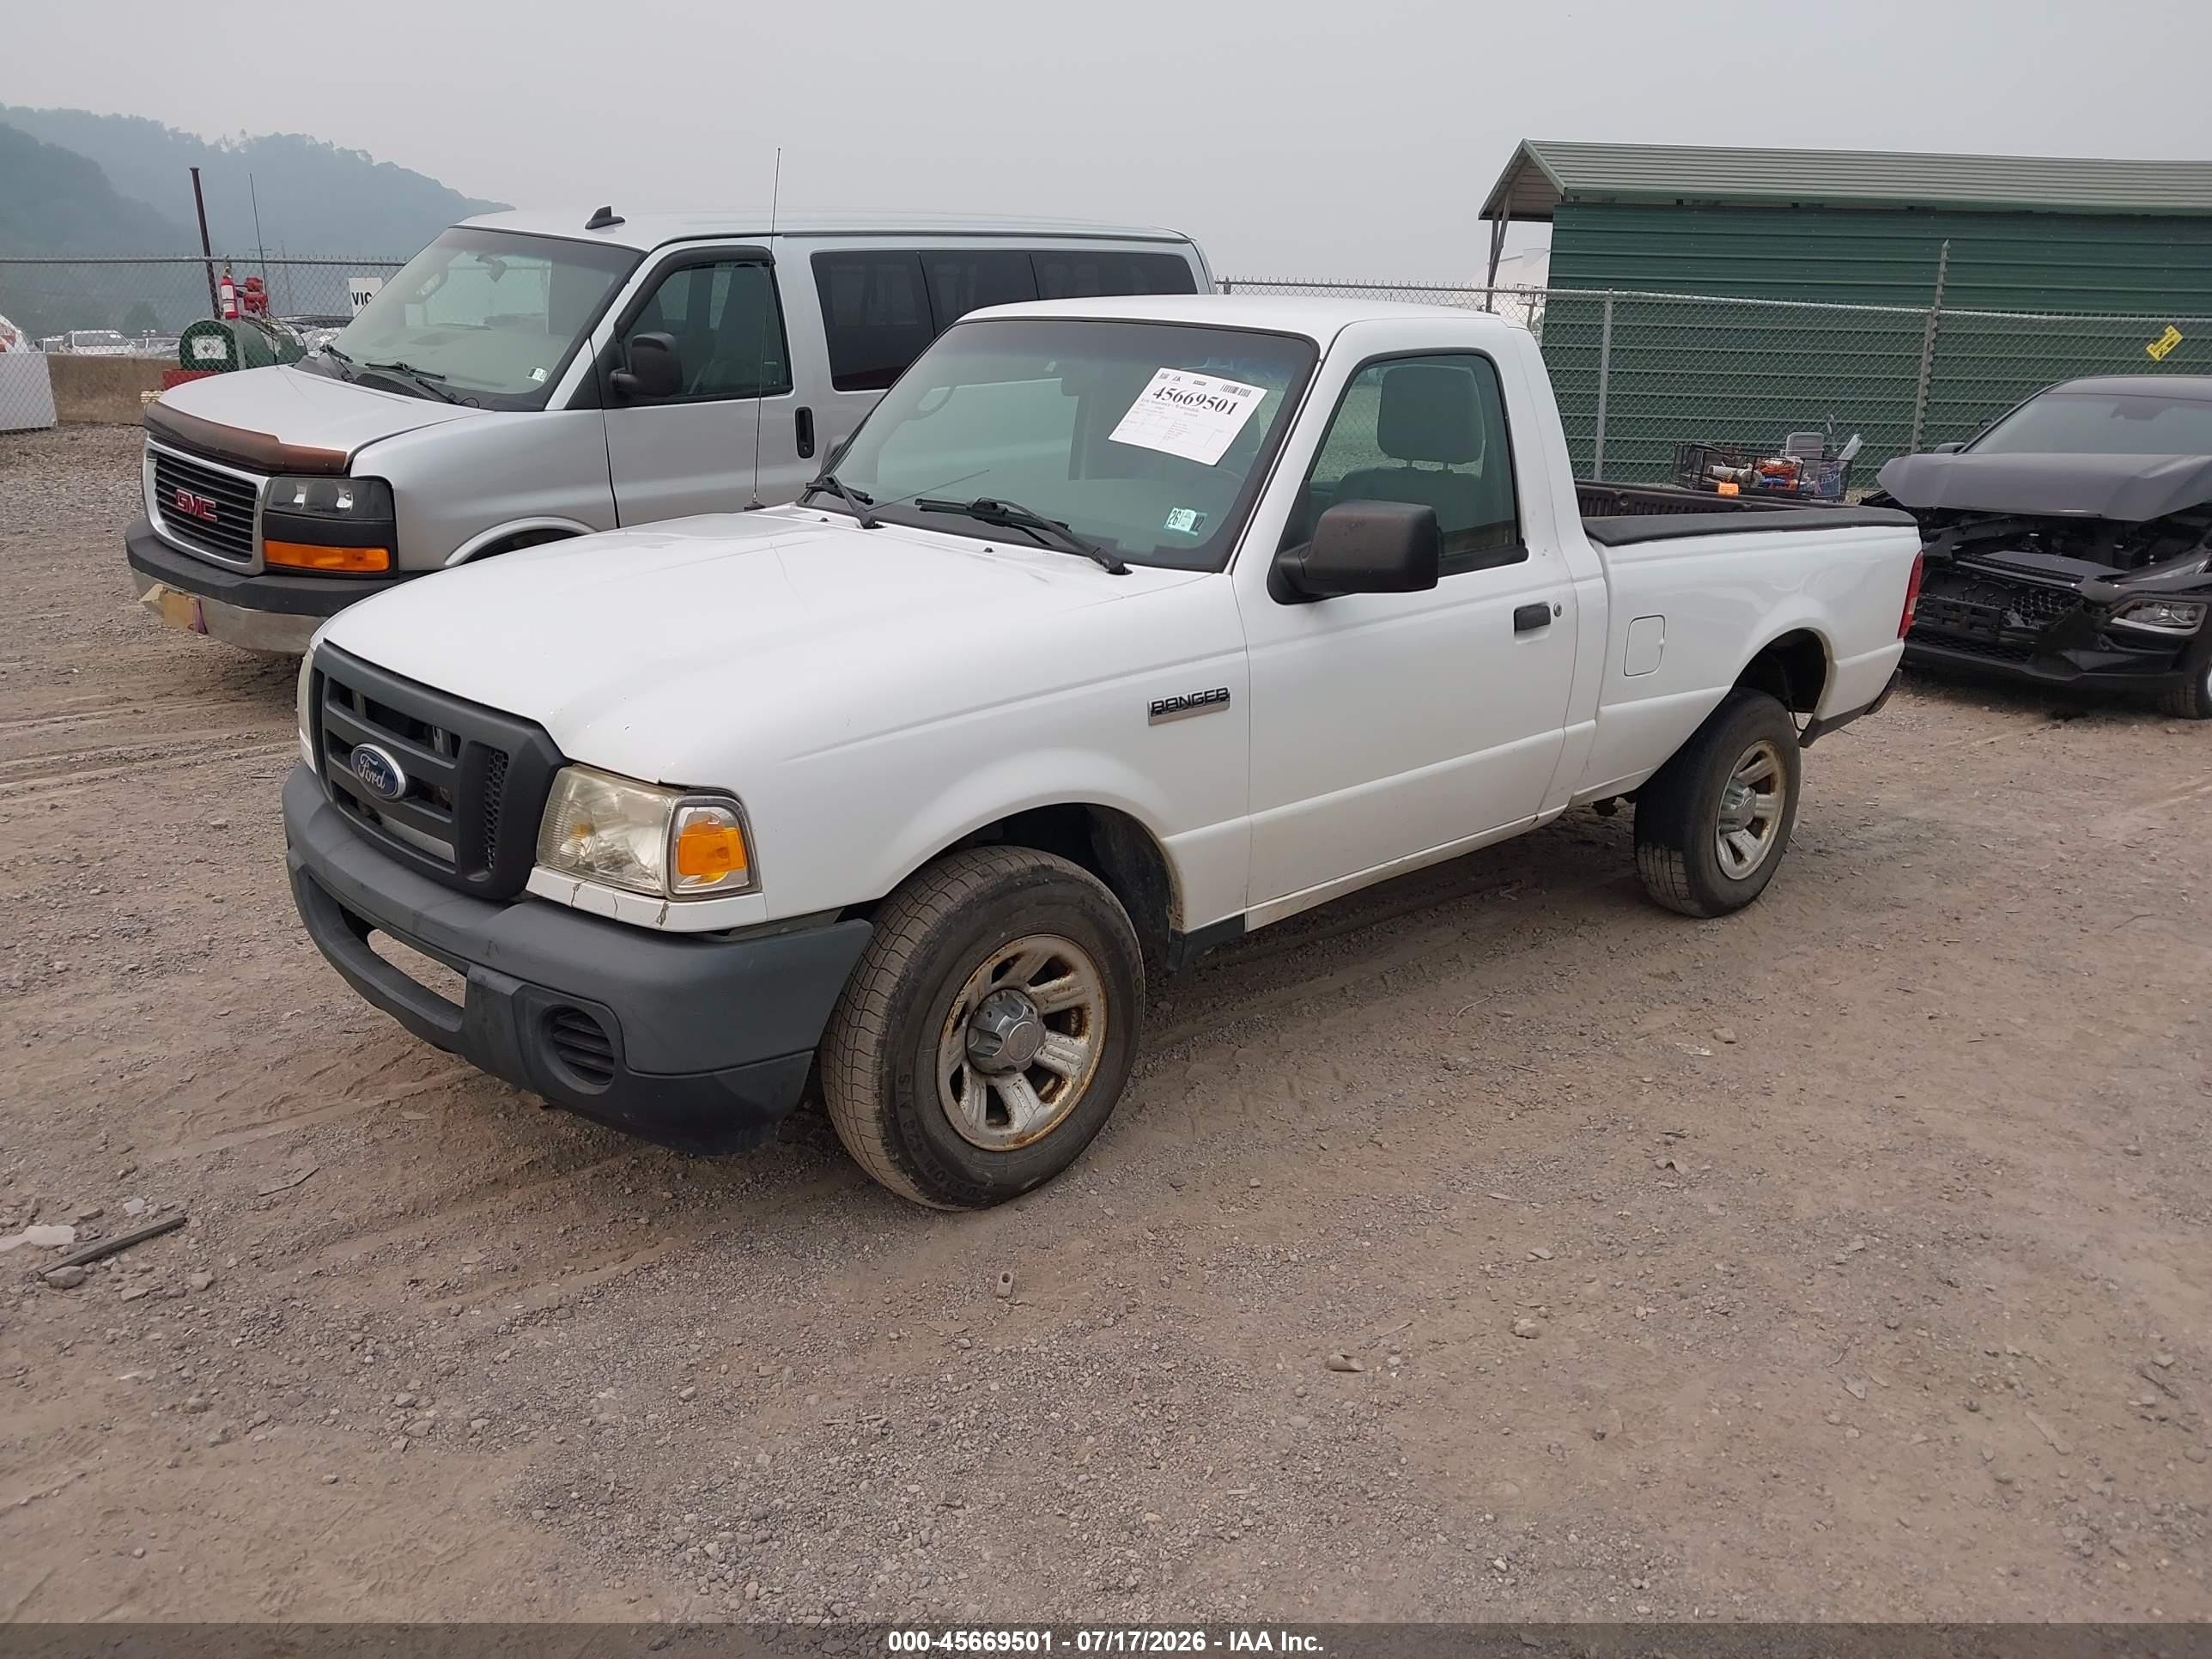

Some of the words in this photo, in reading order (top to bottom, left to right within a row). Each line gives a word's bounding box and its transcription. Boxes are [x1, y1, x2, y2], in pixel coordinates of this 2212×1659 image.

[1152, 386, 1239, 415] 45669501
[174, 488, 218, 522] GMC
[1168, 509, 1182, 526] 26
[1150, 686, 1230, 717] RANGER
[358, 752, 386, 789] Ford
